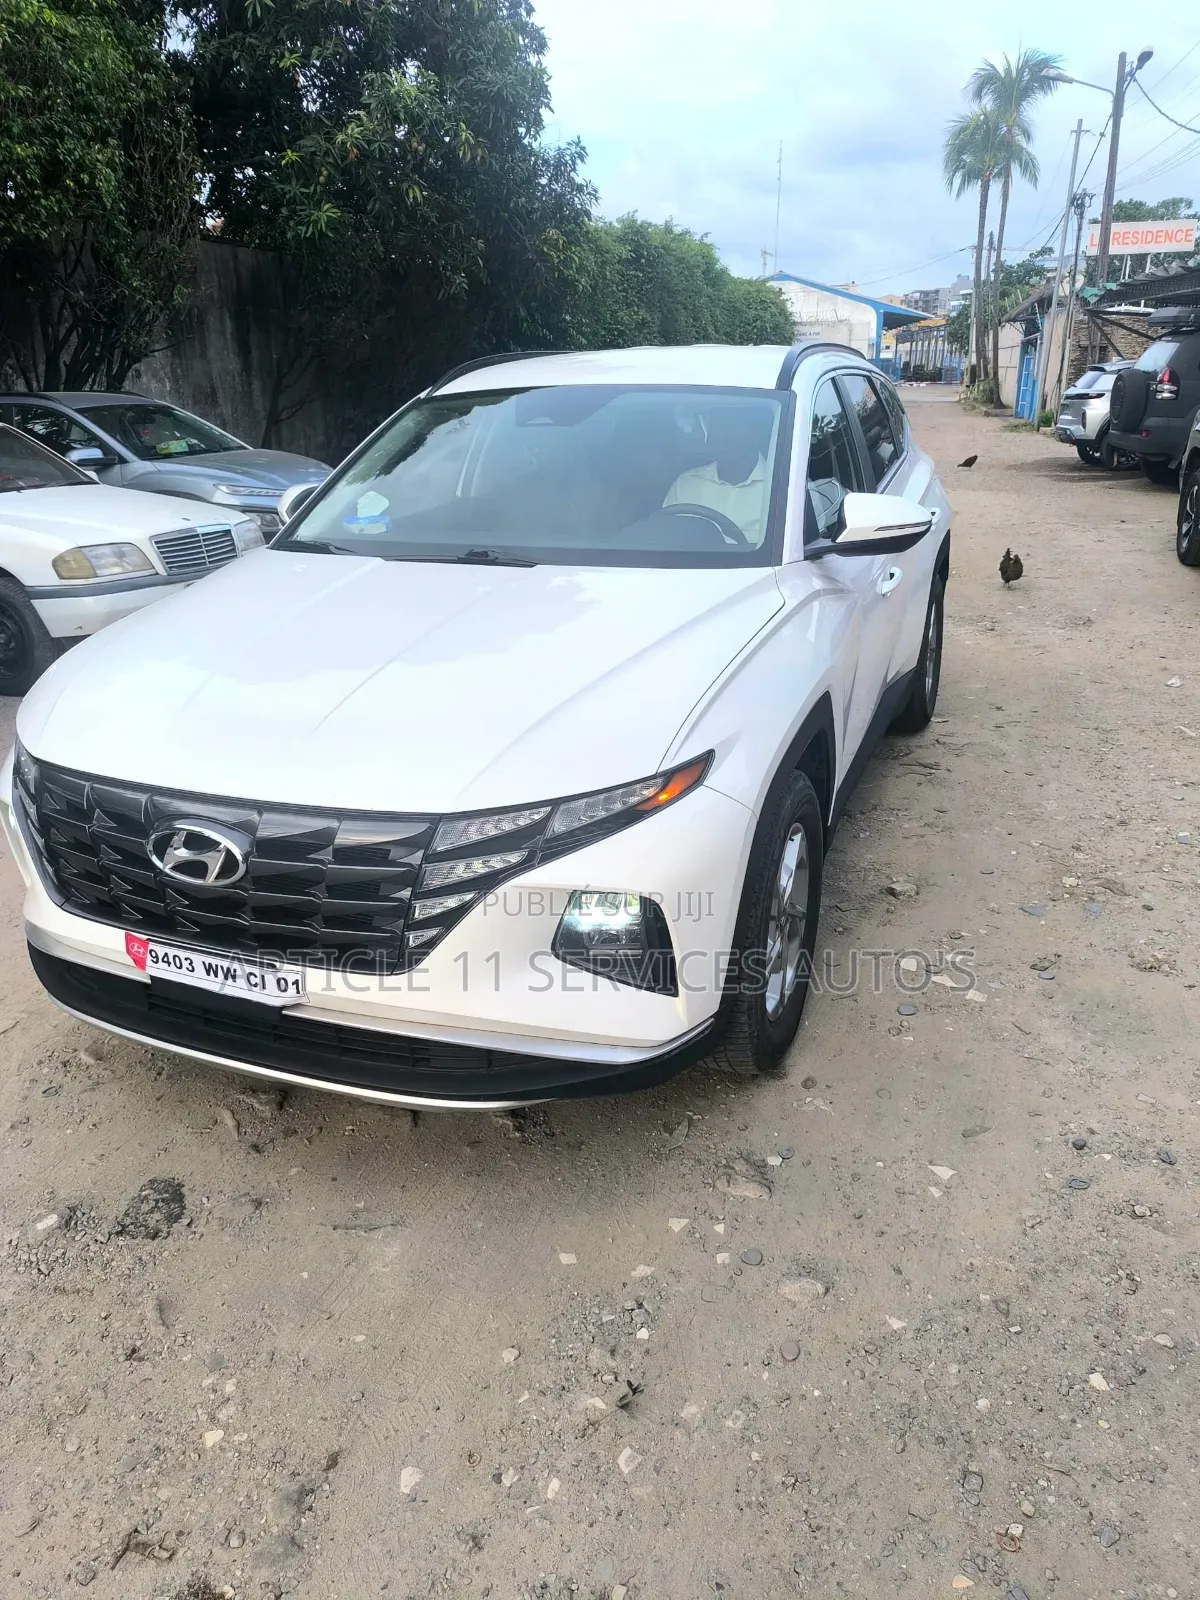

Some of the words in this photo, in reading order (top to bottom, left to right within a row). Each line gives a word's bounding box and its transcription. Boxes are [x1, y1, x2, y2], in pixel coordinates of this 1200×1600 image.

[1111, 228, 1194, 246] RESIDENCE
[149, 948, 195, 973] 9403
[202, 960, 237, 983] WW
[247, 971, 267, 990] CI
[277, 976, 301, 995] 01
